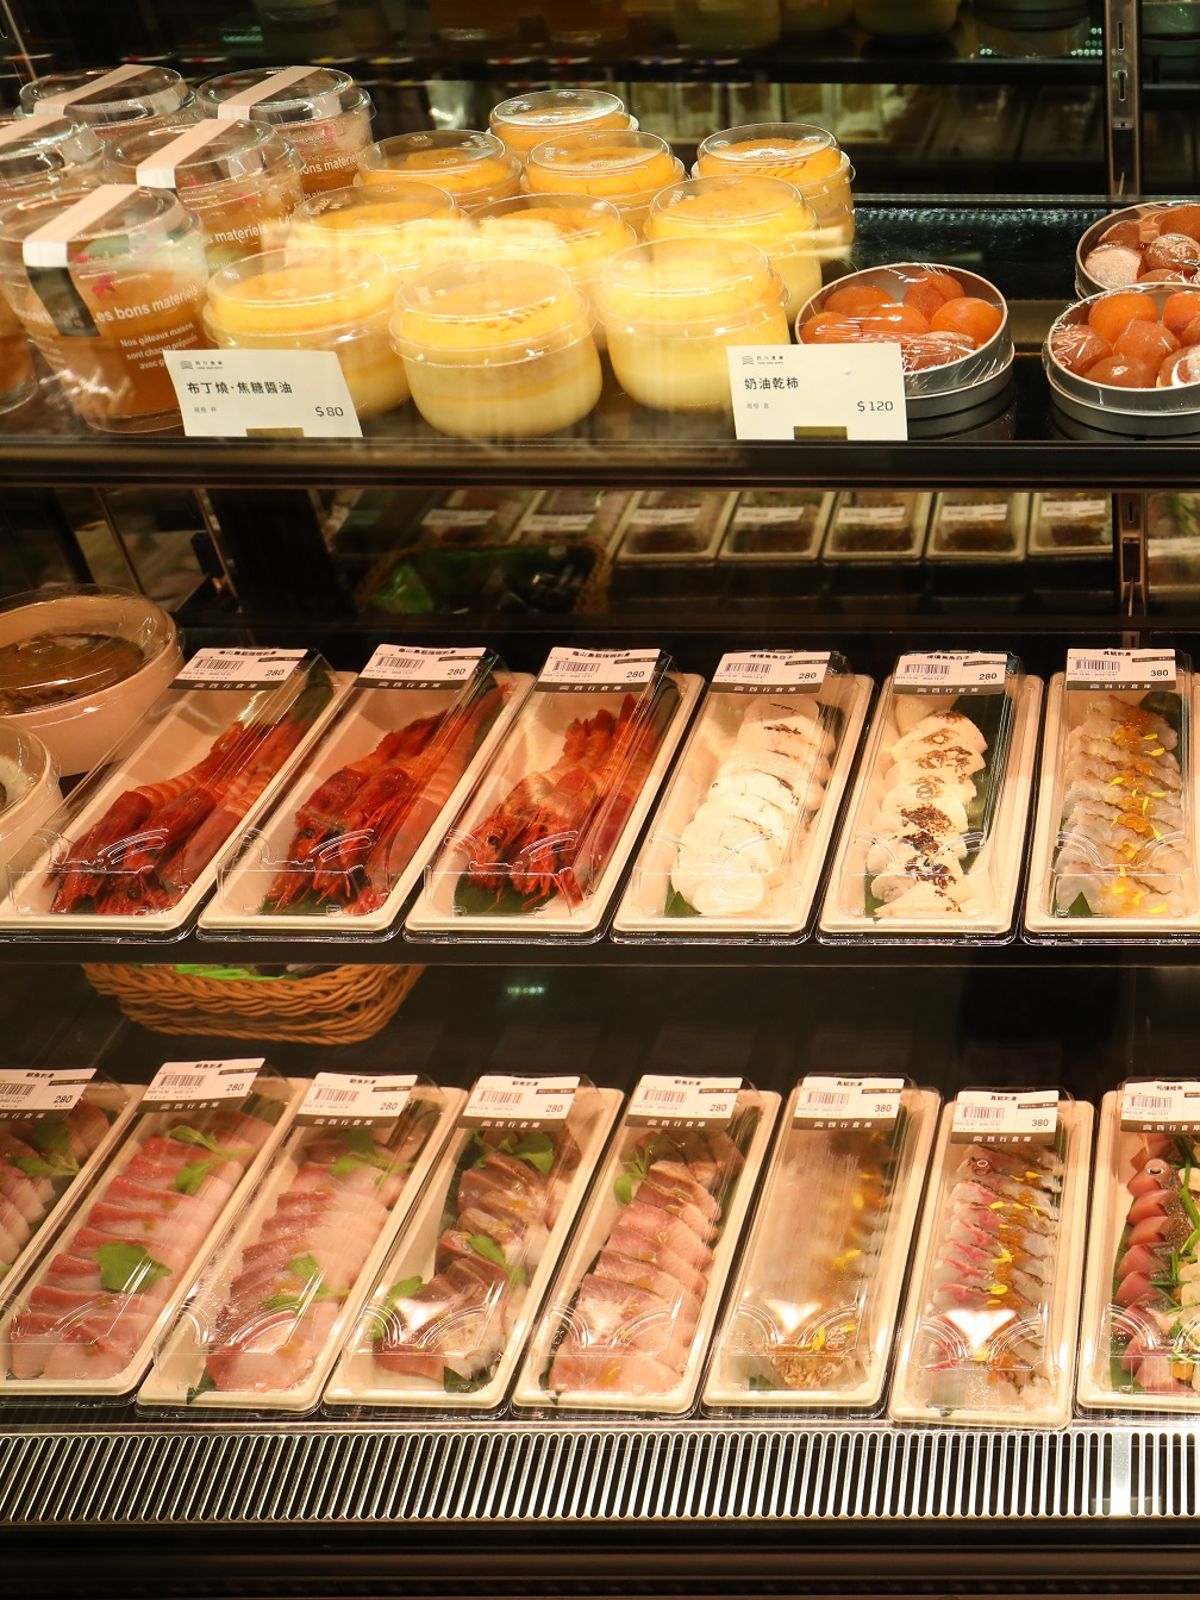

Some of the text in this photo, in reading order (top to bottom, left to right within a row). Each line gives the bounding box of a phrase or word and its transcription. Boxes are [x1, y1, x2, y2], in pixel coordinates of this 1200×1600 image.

[113, 302, 151, 320] bons
[120, 336, 139, 348] Nos
[744, 376, 799, 391] 奶油乾柿
[264, 668, 285, 678] 280
[446, 668, 467, 676] 280
[625, 670, 646, 679] 280
[797, 671, 818, 680] 280
[978, 672, 998, 681] 280
[1150, 669, 1169, 677] 380
[225, 1083, 245, 1092] 280
[53, 1094, 74, 1104] 280
[379, 1102, 399, 1111] 280
[545, 1104, 564, 1113] 280
[709, 1103, 728, 1112] 280
[874, 1104, 893, 1113] 380
[1031, 1118, 1050, 1127] 380
